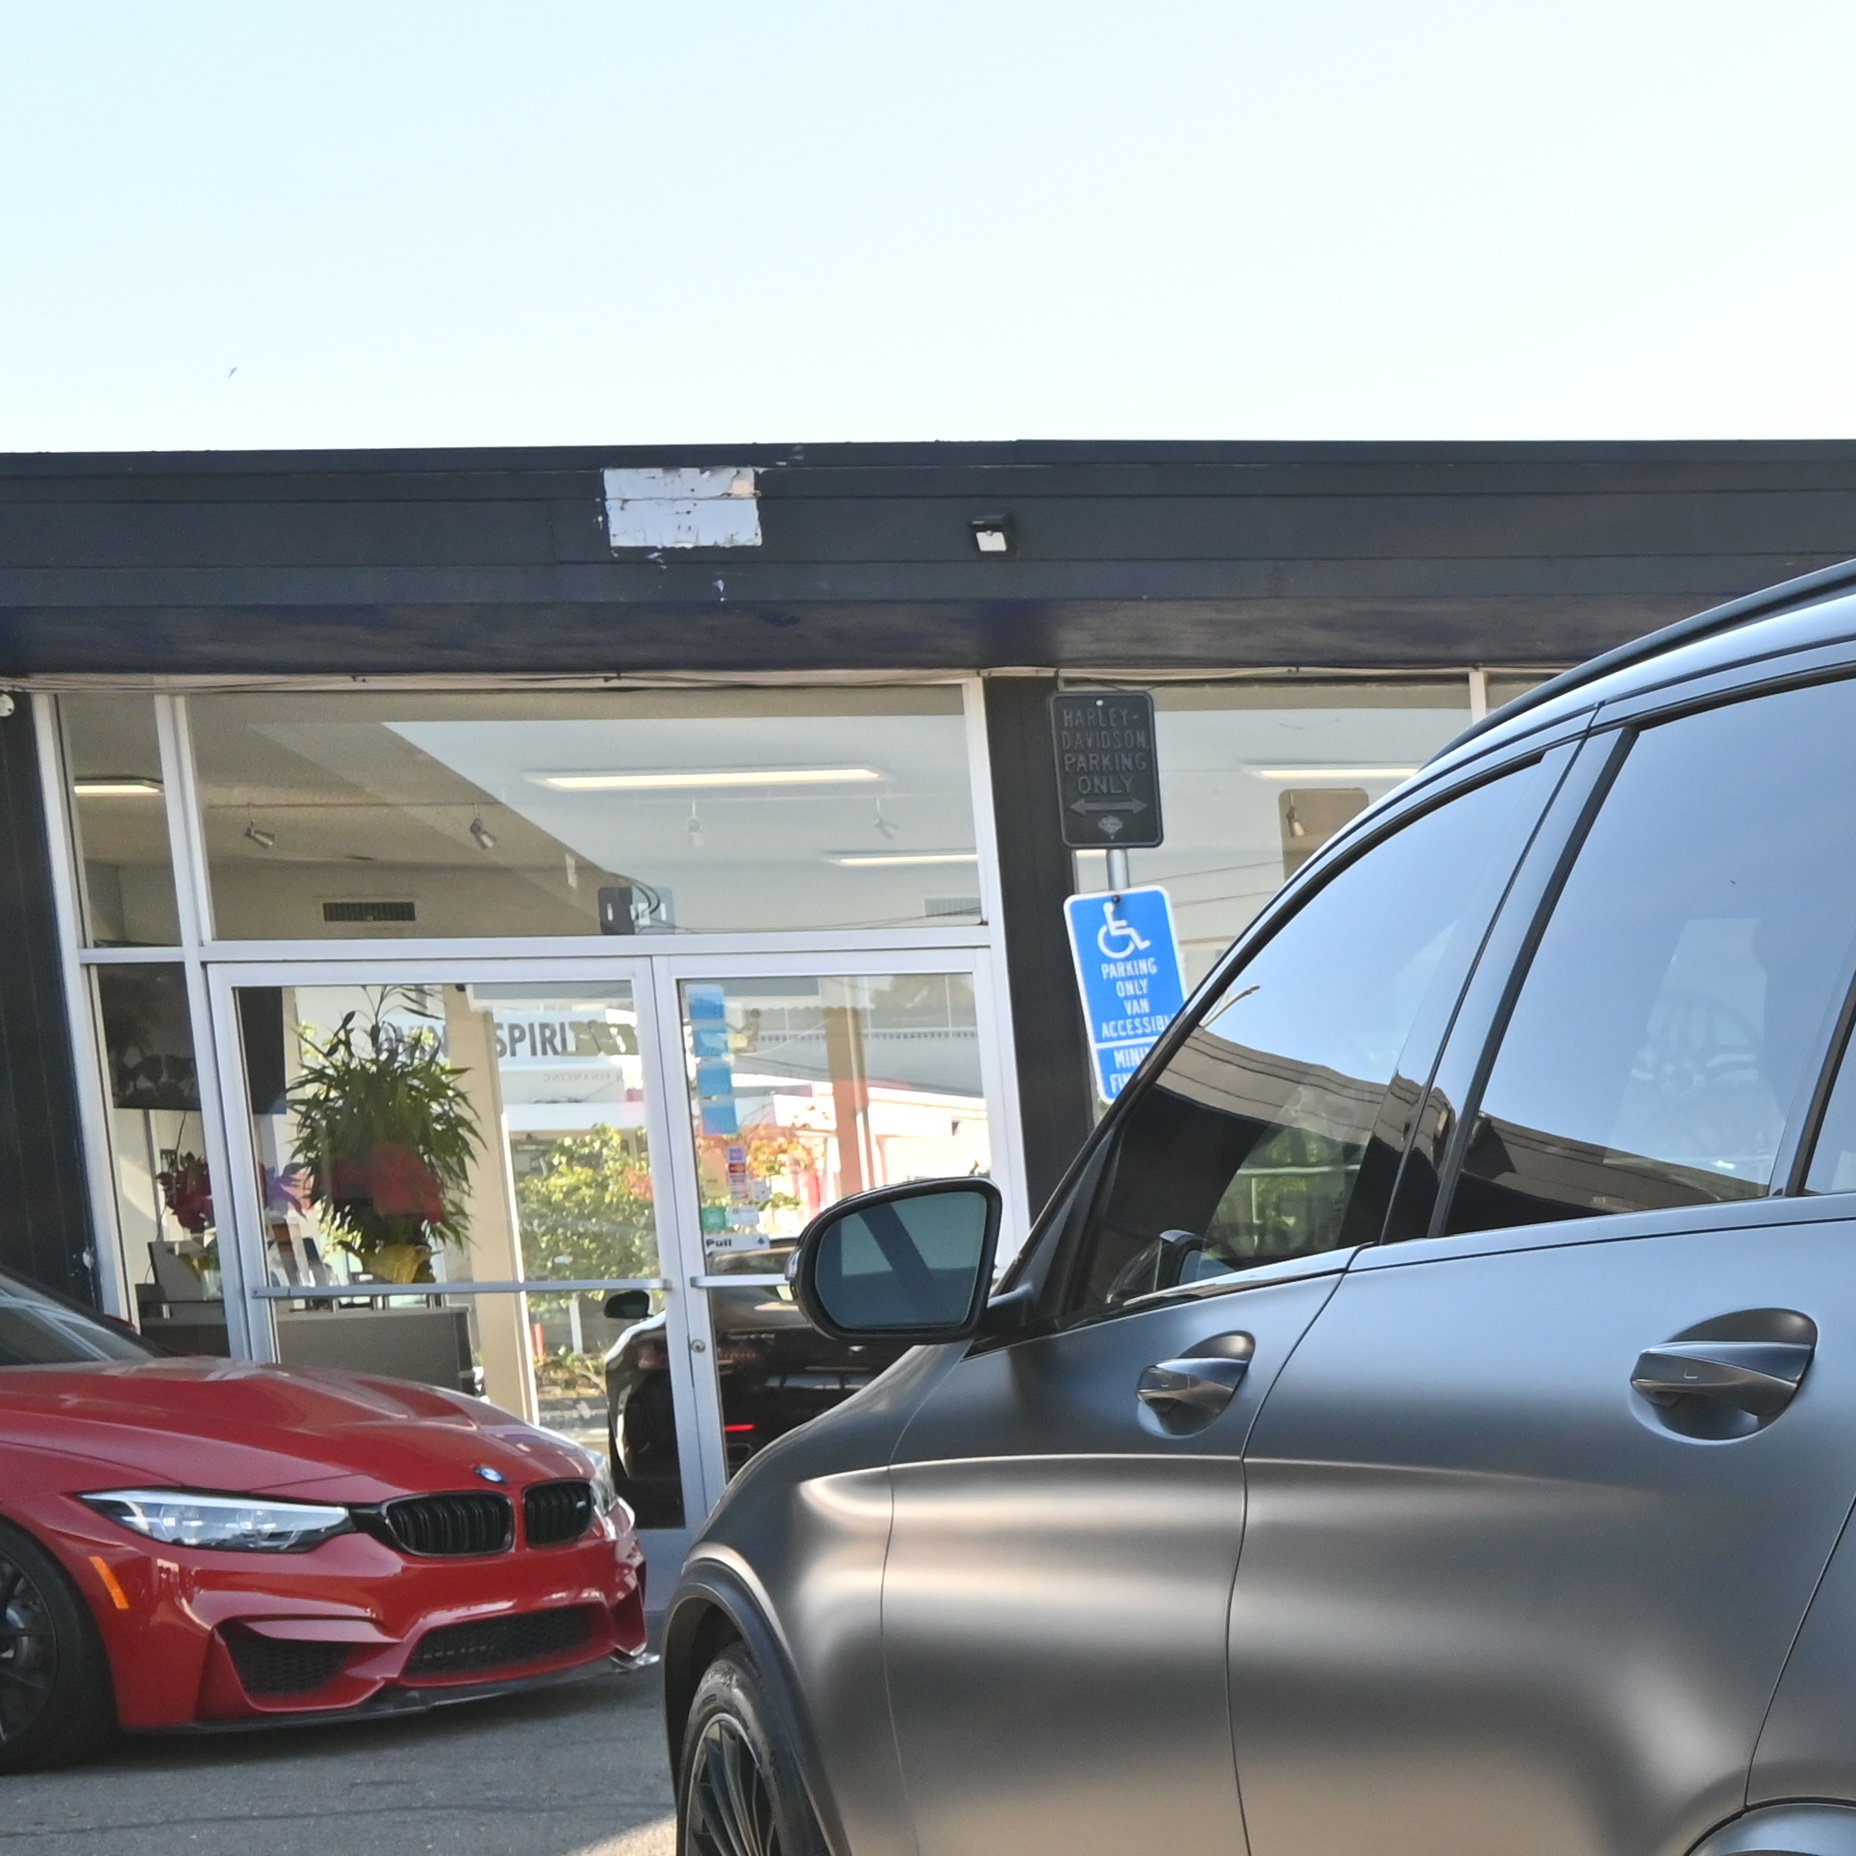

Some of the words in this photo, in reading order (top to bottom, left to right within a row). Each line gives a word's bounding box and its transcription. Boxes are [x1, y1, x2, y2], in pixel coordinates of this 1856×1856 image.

[1063, 708, 1139, 727] HARLEY-
[1061, 730, 1147, 750] DAVIDSON
[1064, 752, 1146, 772] PARKING
[1078, 775, 1134, 794] ONLY
[1101, 957, 1158, 980] PARKING
[1115, 978, 1149, 999] ONLY
[1123, 998, 1150, 1016] VAN
[705, 1237, 732, 1248] Pull
